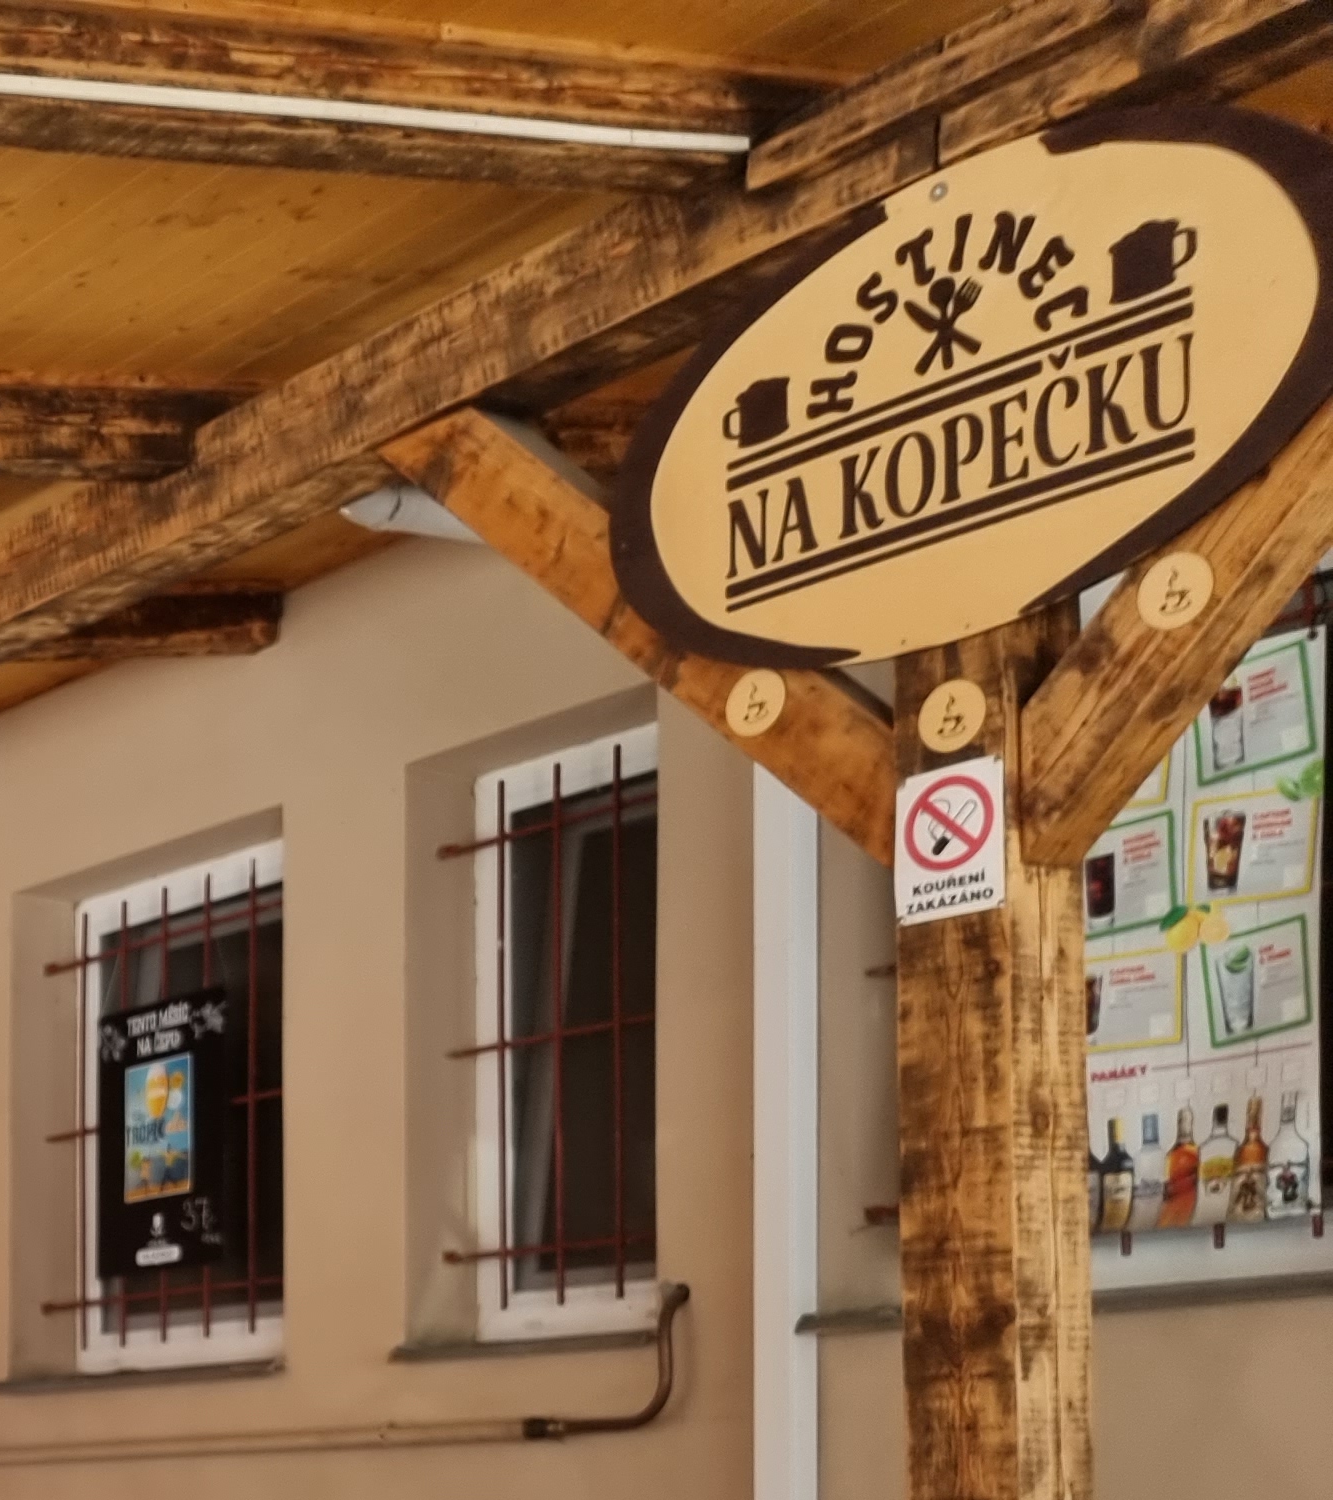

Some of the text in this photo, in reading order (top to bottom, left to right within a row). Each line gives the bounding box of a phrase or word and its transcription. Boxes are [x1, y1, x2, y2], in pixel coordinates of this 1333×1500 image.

[806, 211, 1088, 420] HOSTINEC
[726, 333, 1193, 579] NA KOPEČKU
[913, 868, 985, 896] KOUŘENÍ
[907, 888, 994, 915] ZAKÁZÁNO
[136, 1036, 152, 1057] NA
